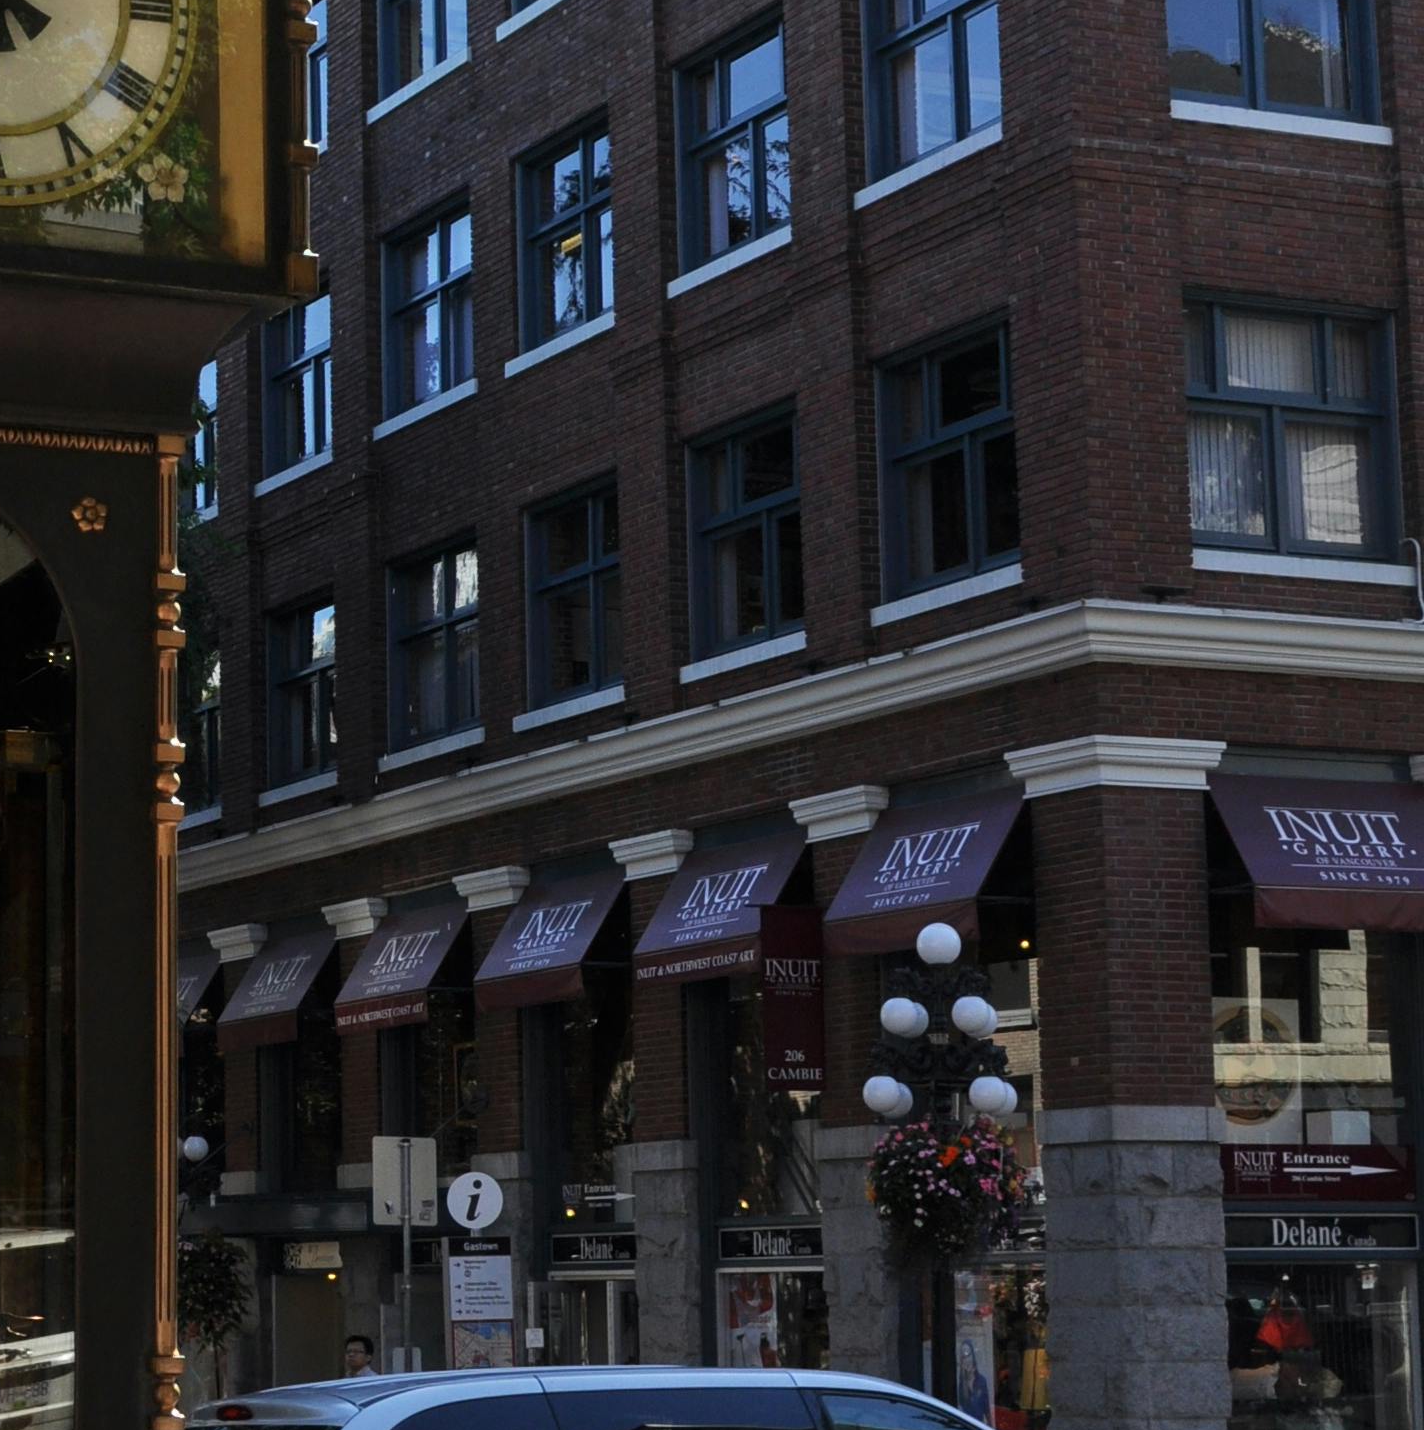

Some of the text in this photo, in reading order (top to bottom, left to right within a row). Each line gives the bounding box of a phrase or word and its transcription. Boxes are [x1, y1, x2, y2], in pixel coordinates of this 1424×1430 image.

[1264, 808, 1406, 846] INUIT
[879, 823, 980, 872] INUIT
[1293, 842, 1406, 859] GALLERY
[879, 860, 955, 884] GALLERY
[1319, 871, 1411, 886] SINCE 1979
[682, 865, 769, 910] INUIT
[681, 900, 744, 921] GALLERY
[872, 894, 905, 908] SINCE
[518, 901, 593, 940] INUIT
[516, 931, 569, 951] GALLERY
[675, 930, 701, 943] SINCE
[374, 931, 440, 966] INUIT
[664, 955, 712, 977] NORTHWEST
[765, 958, 820, 977] INUIT
[784, 1049, 805, 1062] 206
[767, 1067, 823, 1080] CAMBIE
[1234, 1151, 1277, 1166] INUIT
[1282, 1152, 1350, 1164] Entrance
[1272, 1218, 1342, 1247] Delané
[463, 1242, 499, 1252] Gastown
